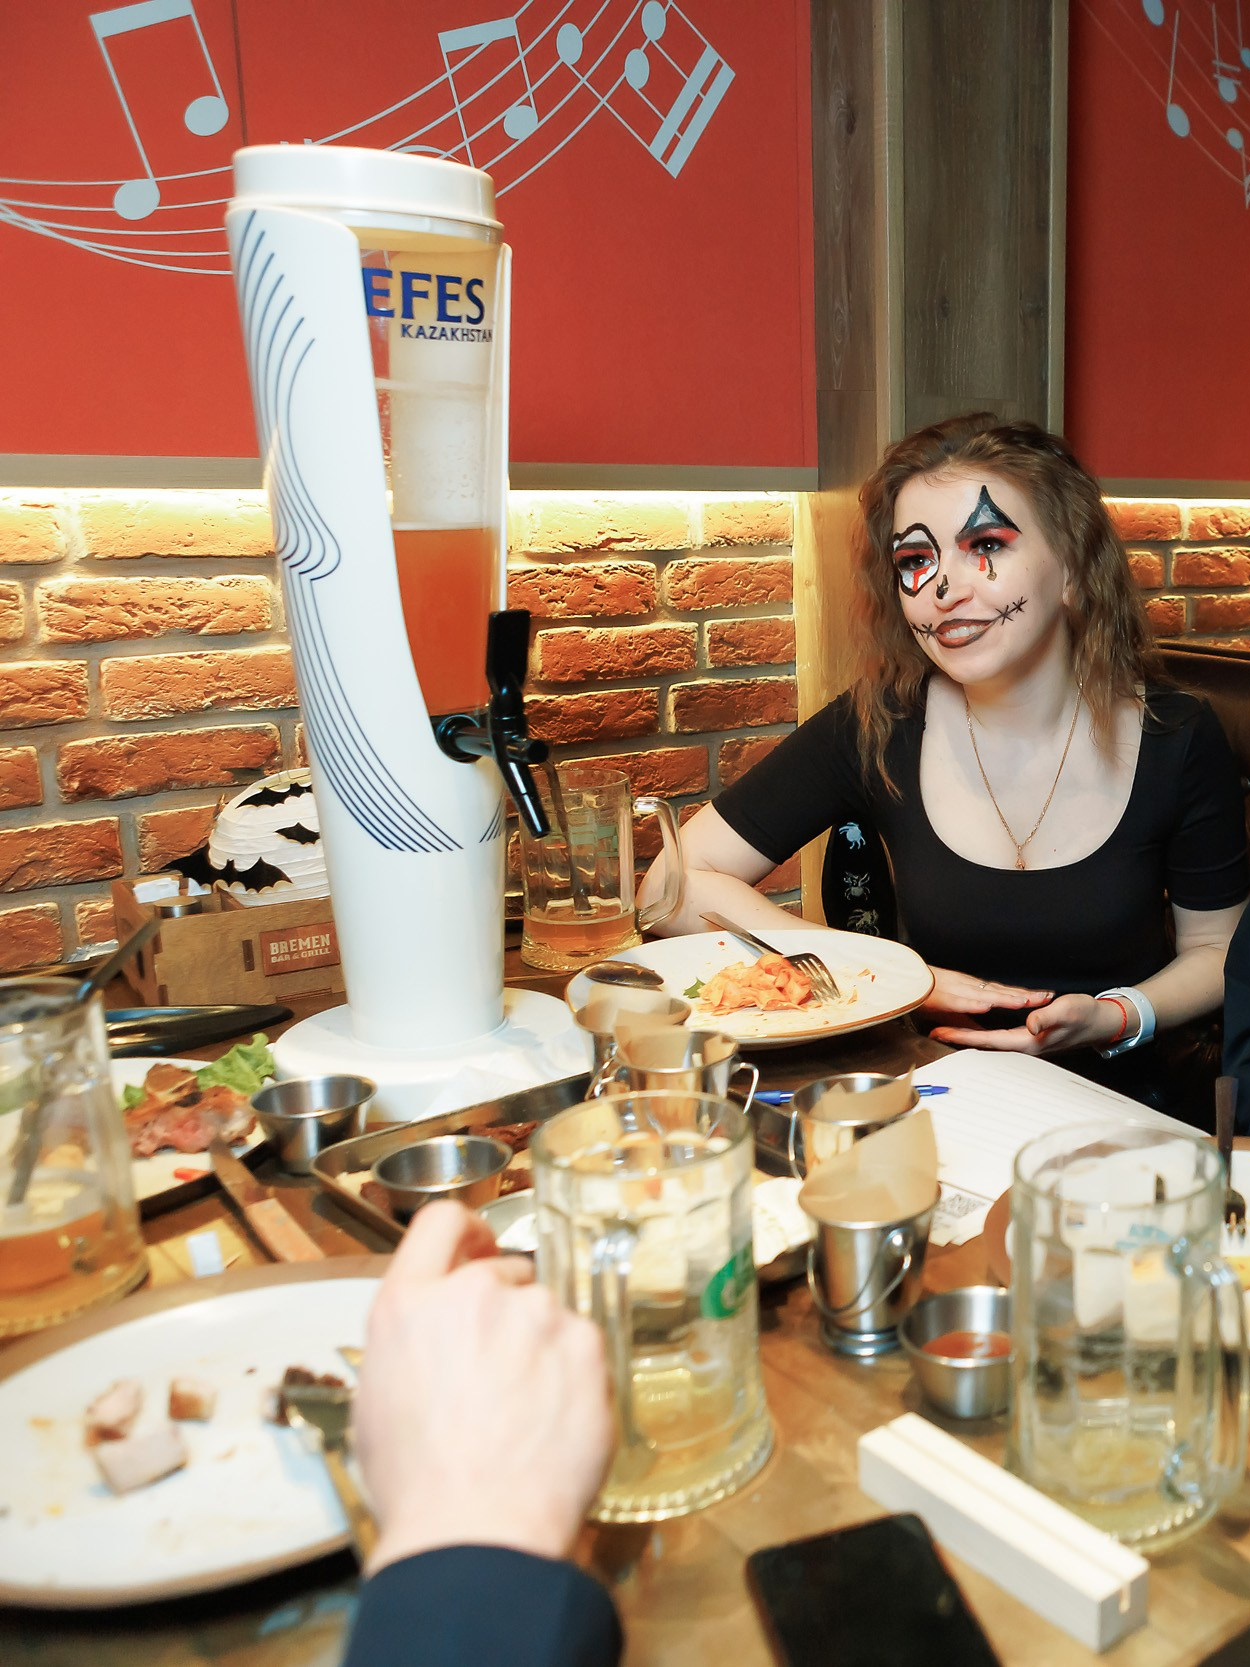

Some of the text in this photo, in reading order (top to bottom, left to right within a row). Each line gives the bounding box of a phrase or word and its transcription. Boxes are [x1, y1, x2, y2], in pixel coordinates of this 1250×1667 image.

[362, 267, 485, 325] EFES
[400, 323, 493, 343] KAZAKHSTAN
[269, 934, 331, 955] BREMEN
[271, 947, 331, 963] BAR & GRILL
